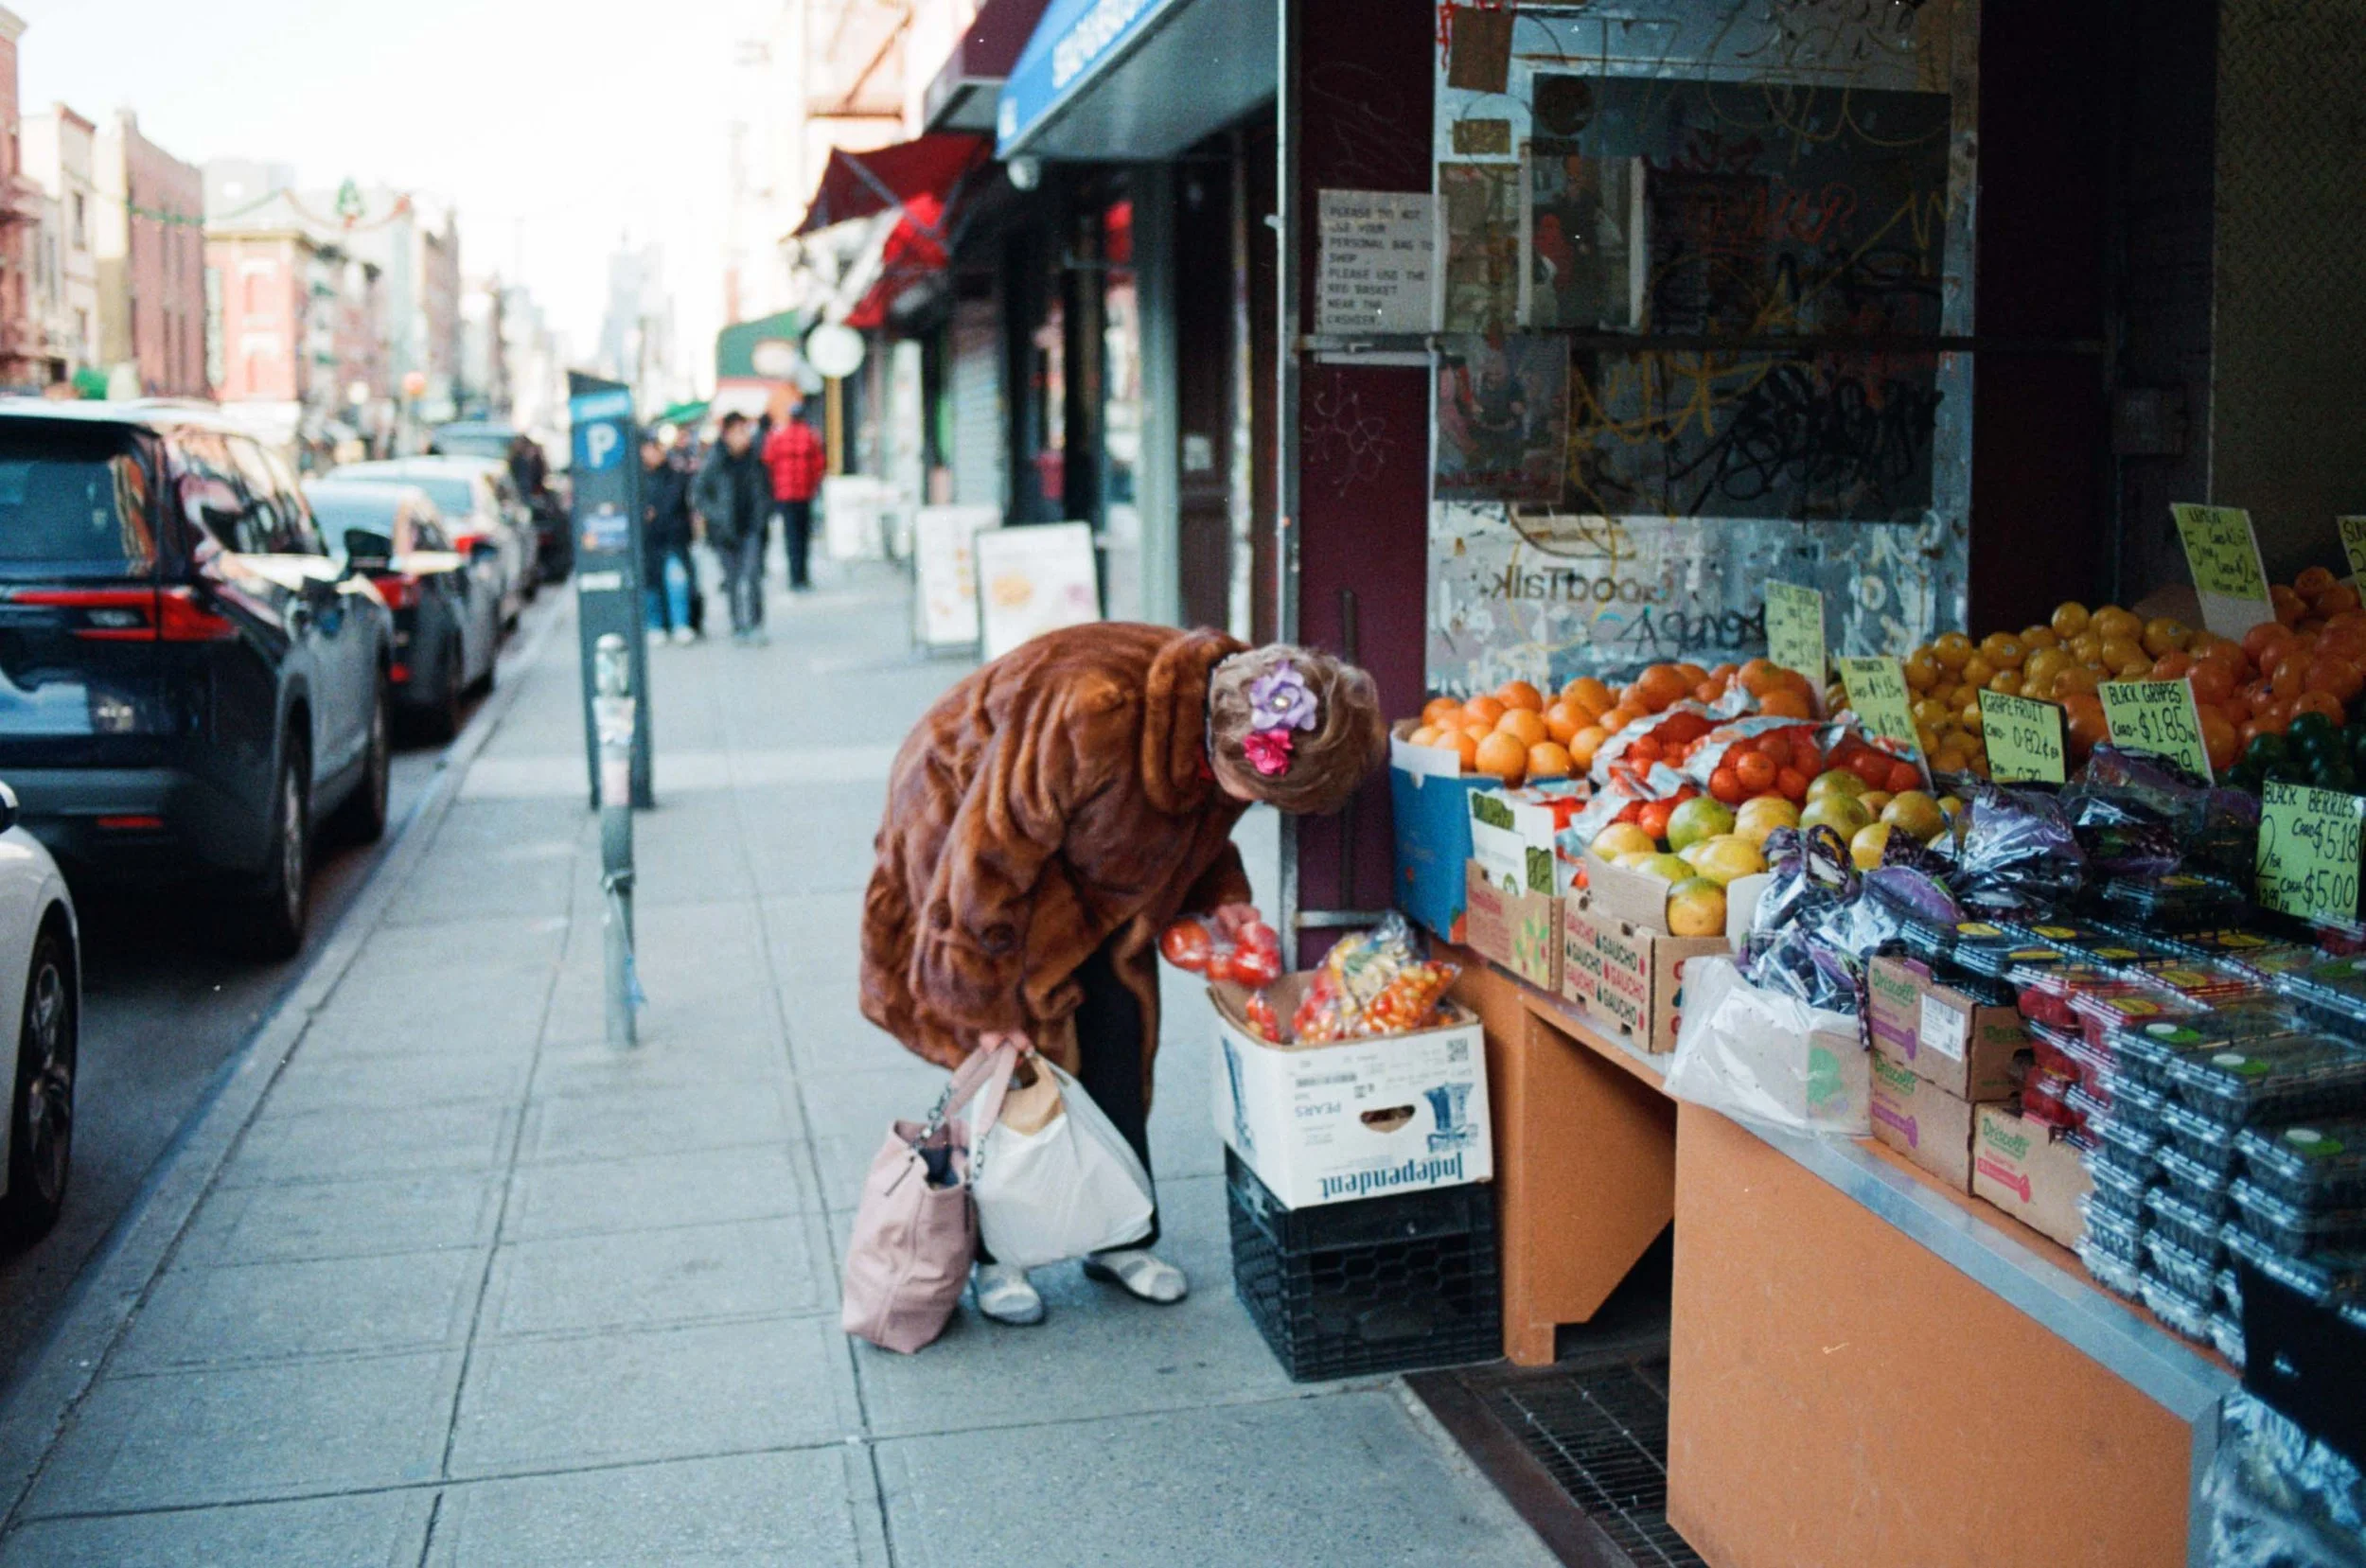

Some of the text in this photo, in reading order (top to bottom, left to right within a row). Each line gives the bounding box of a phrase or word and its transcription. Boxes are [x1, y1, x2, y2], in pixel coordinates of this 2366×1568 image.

[1330, 206, 1370, 218] PLEASE
[1330, 238, 1384, 249] PERSONAL
[1329, 268, 1369, 279] PLEASE
[586, 422, 618, 468] P
[2108, 682, 2181, 707] BLACK GRAPES
[2263, 784, 2298, 805] BLACK
[1601, 935, 1637, 972] GAUCHO
[1572, 942, 1646, 1004] GAUCHO GAUCHO
[1603, 987, 1636, 1027] GAUCHO
[1318, 1151, 1464, 1200] Independent
